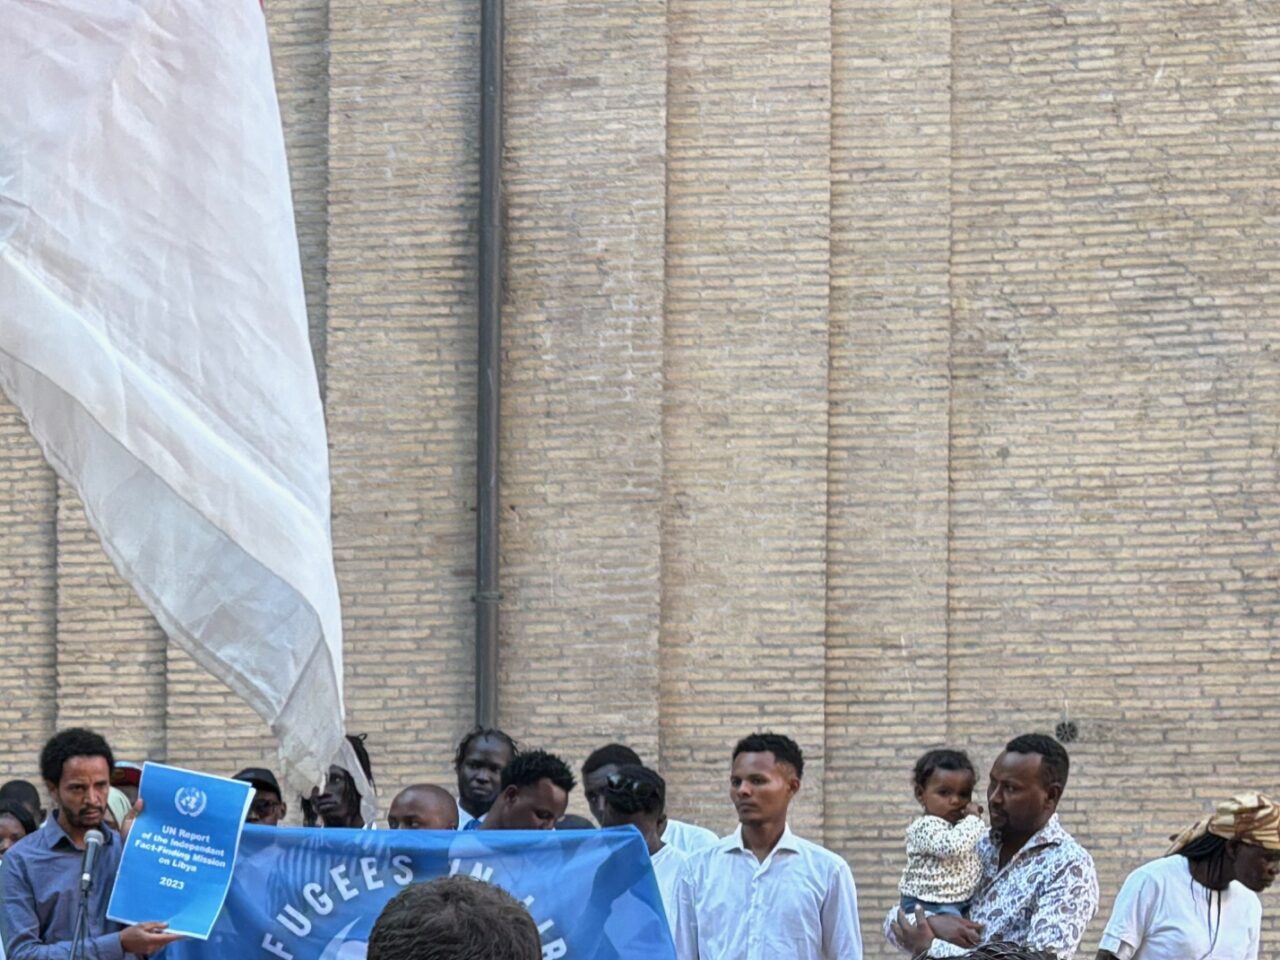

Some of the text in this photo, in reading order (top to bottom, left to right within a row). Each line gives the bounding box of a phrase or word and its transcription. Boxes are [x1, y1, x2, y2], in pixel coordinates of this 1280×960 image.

[153, 834, 169, 845] the
[162, 825, 210, 843] UN Report
[134, 839, 226, 868] Fact-Finding Mission
[158, 857, 198, 873] on Libya
[159, 876, 185, 890] 2023
